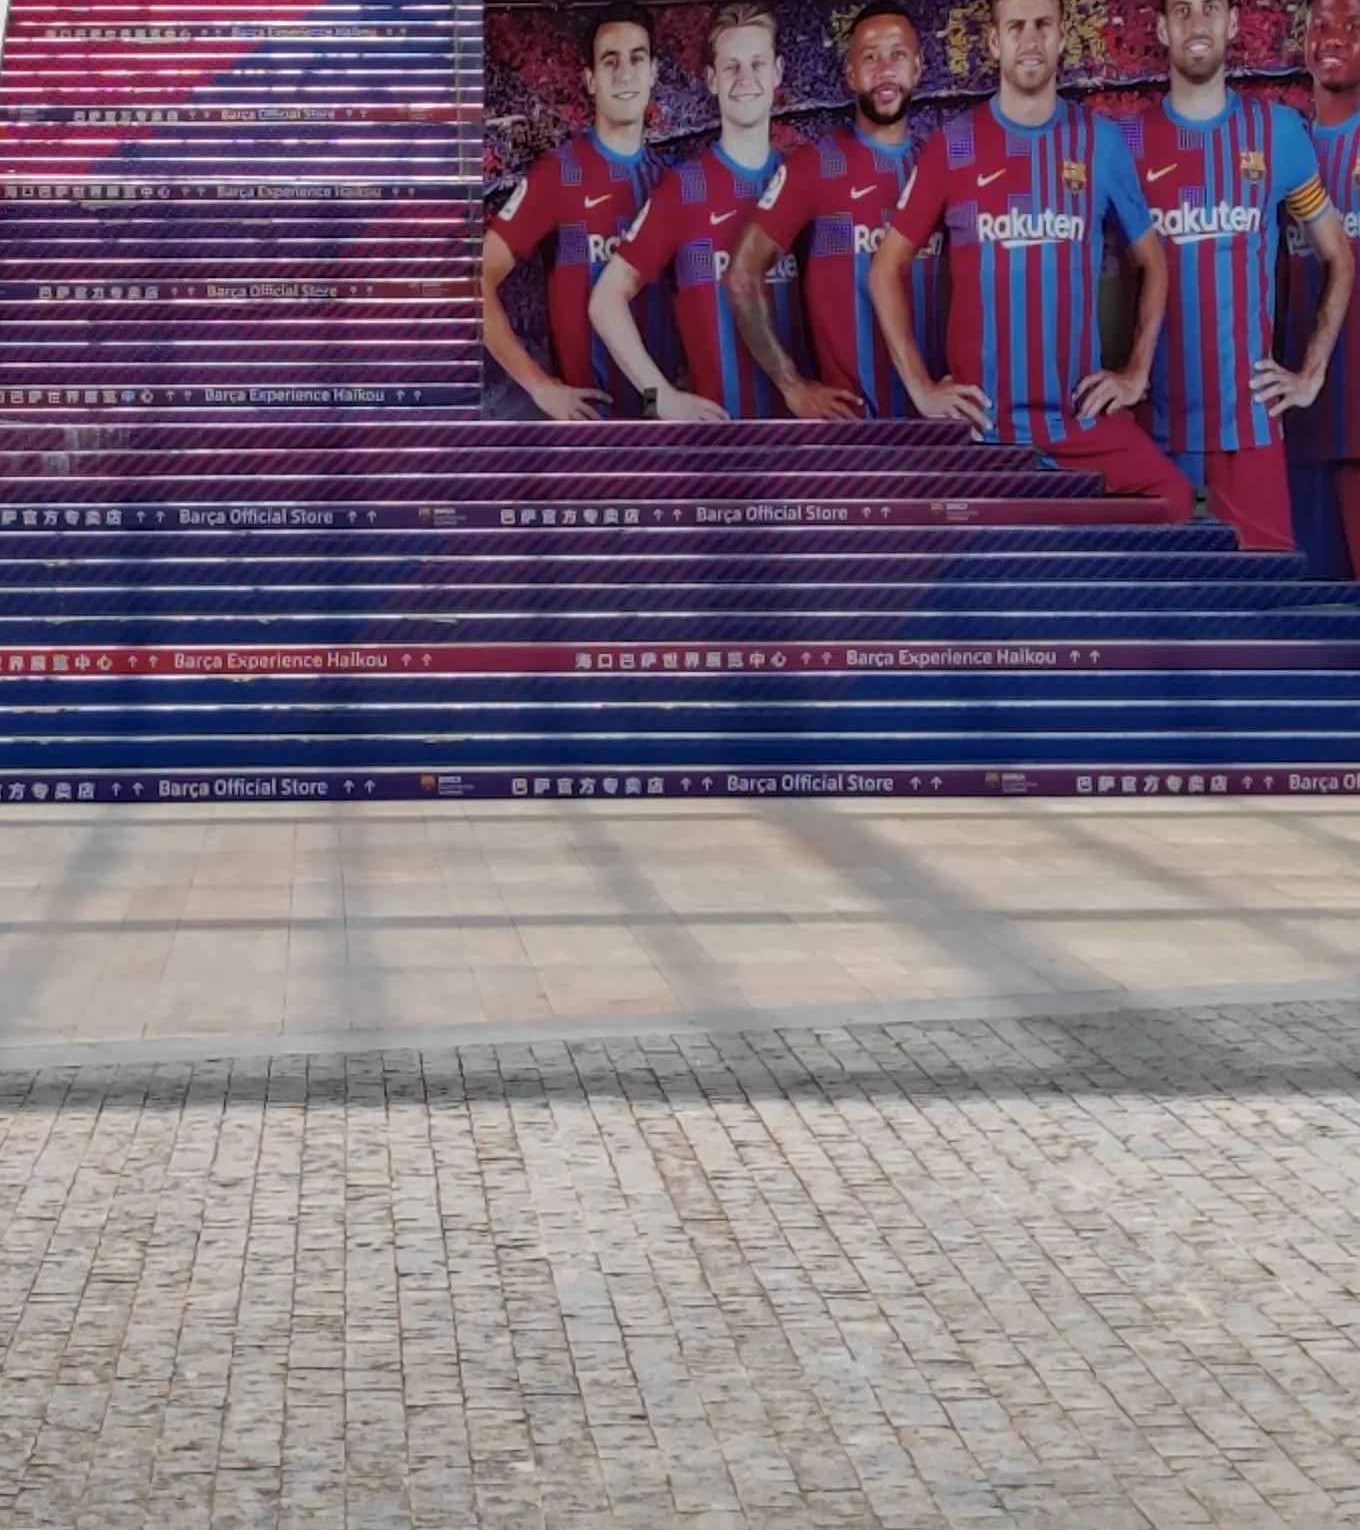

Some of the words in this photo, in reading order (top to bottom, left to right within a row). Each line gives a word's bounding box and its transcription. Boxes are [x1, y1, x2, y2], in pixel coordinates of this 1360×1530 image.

[977, 207, 1085, 244] Rakuten
[1148, 201, 1262, 238] Rakuten
[179, 508, 227, 527] Barça
[229, 508, 287, 525] Official
[291, 508, 334, 525] Store
[696, 506, 742, 524] Barça
[745, 505, 803, 522] Official
[806, 506, 848, 522] Store
[174, 652, 222, 671] Barça
[227, 652, 323, 671] Experience
[327, 651, 388, 669] Haikou
[846, 649, 895, 667] Barça
[899, 649, 994, 667] Experience
[997, 648, 1058, 666] Haikou
[158, 779, 210, 798] Barça
[214, 778, 277, 796] Official
[281, 778, 329, 796] Store
[726, 775, 777, 793] Barça
[781, 774, 842, 792] Official
[846, 774, 895, 792] Store
[1288, 773, 1339, 793] Barça
